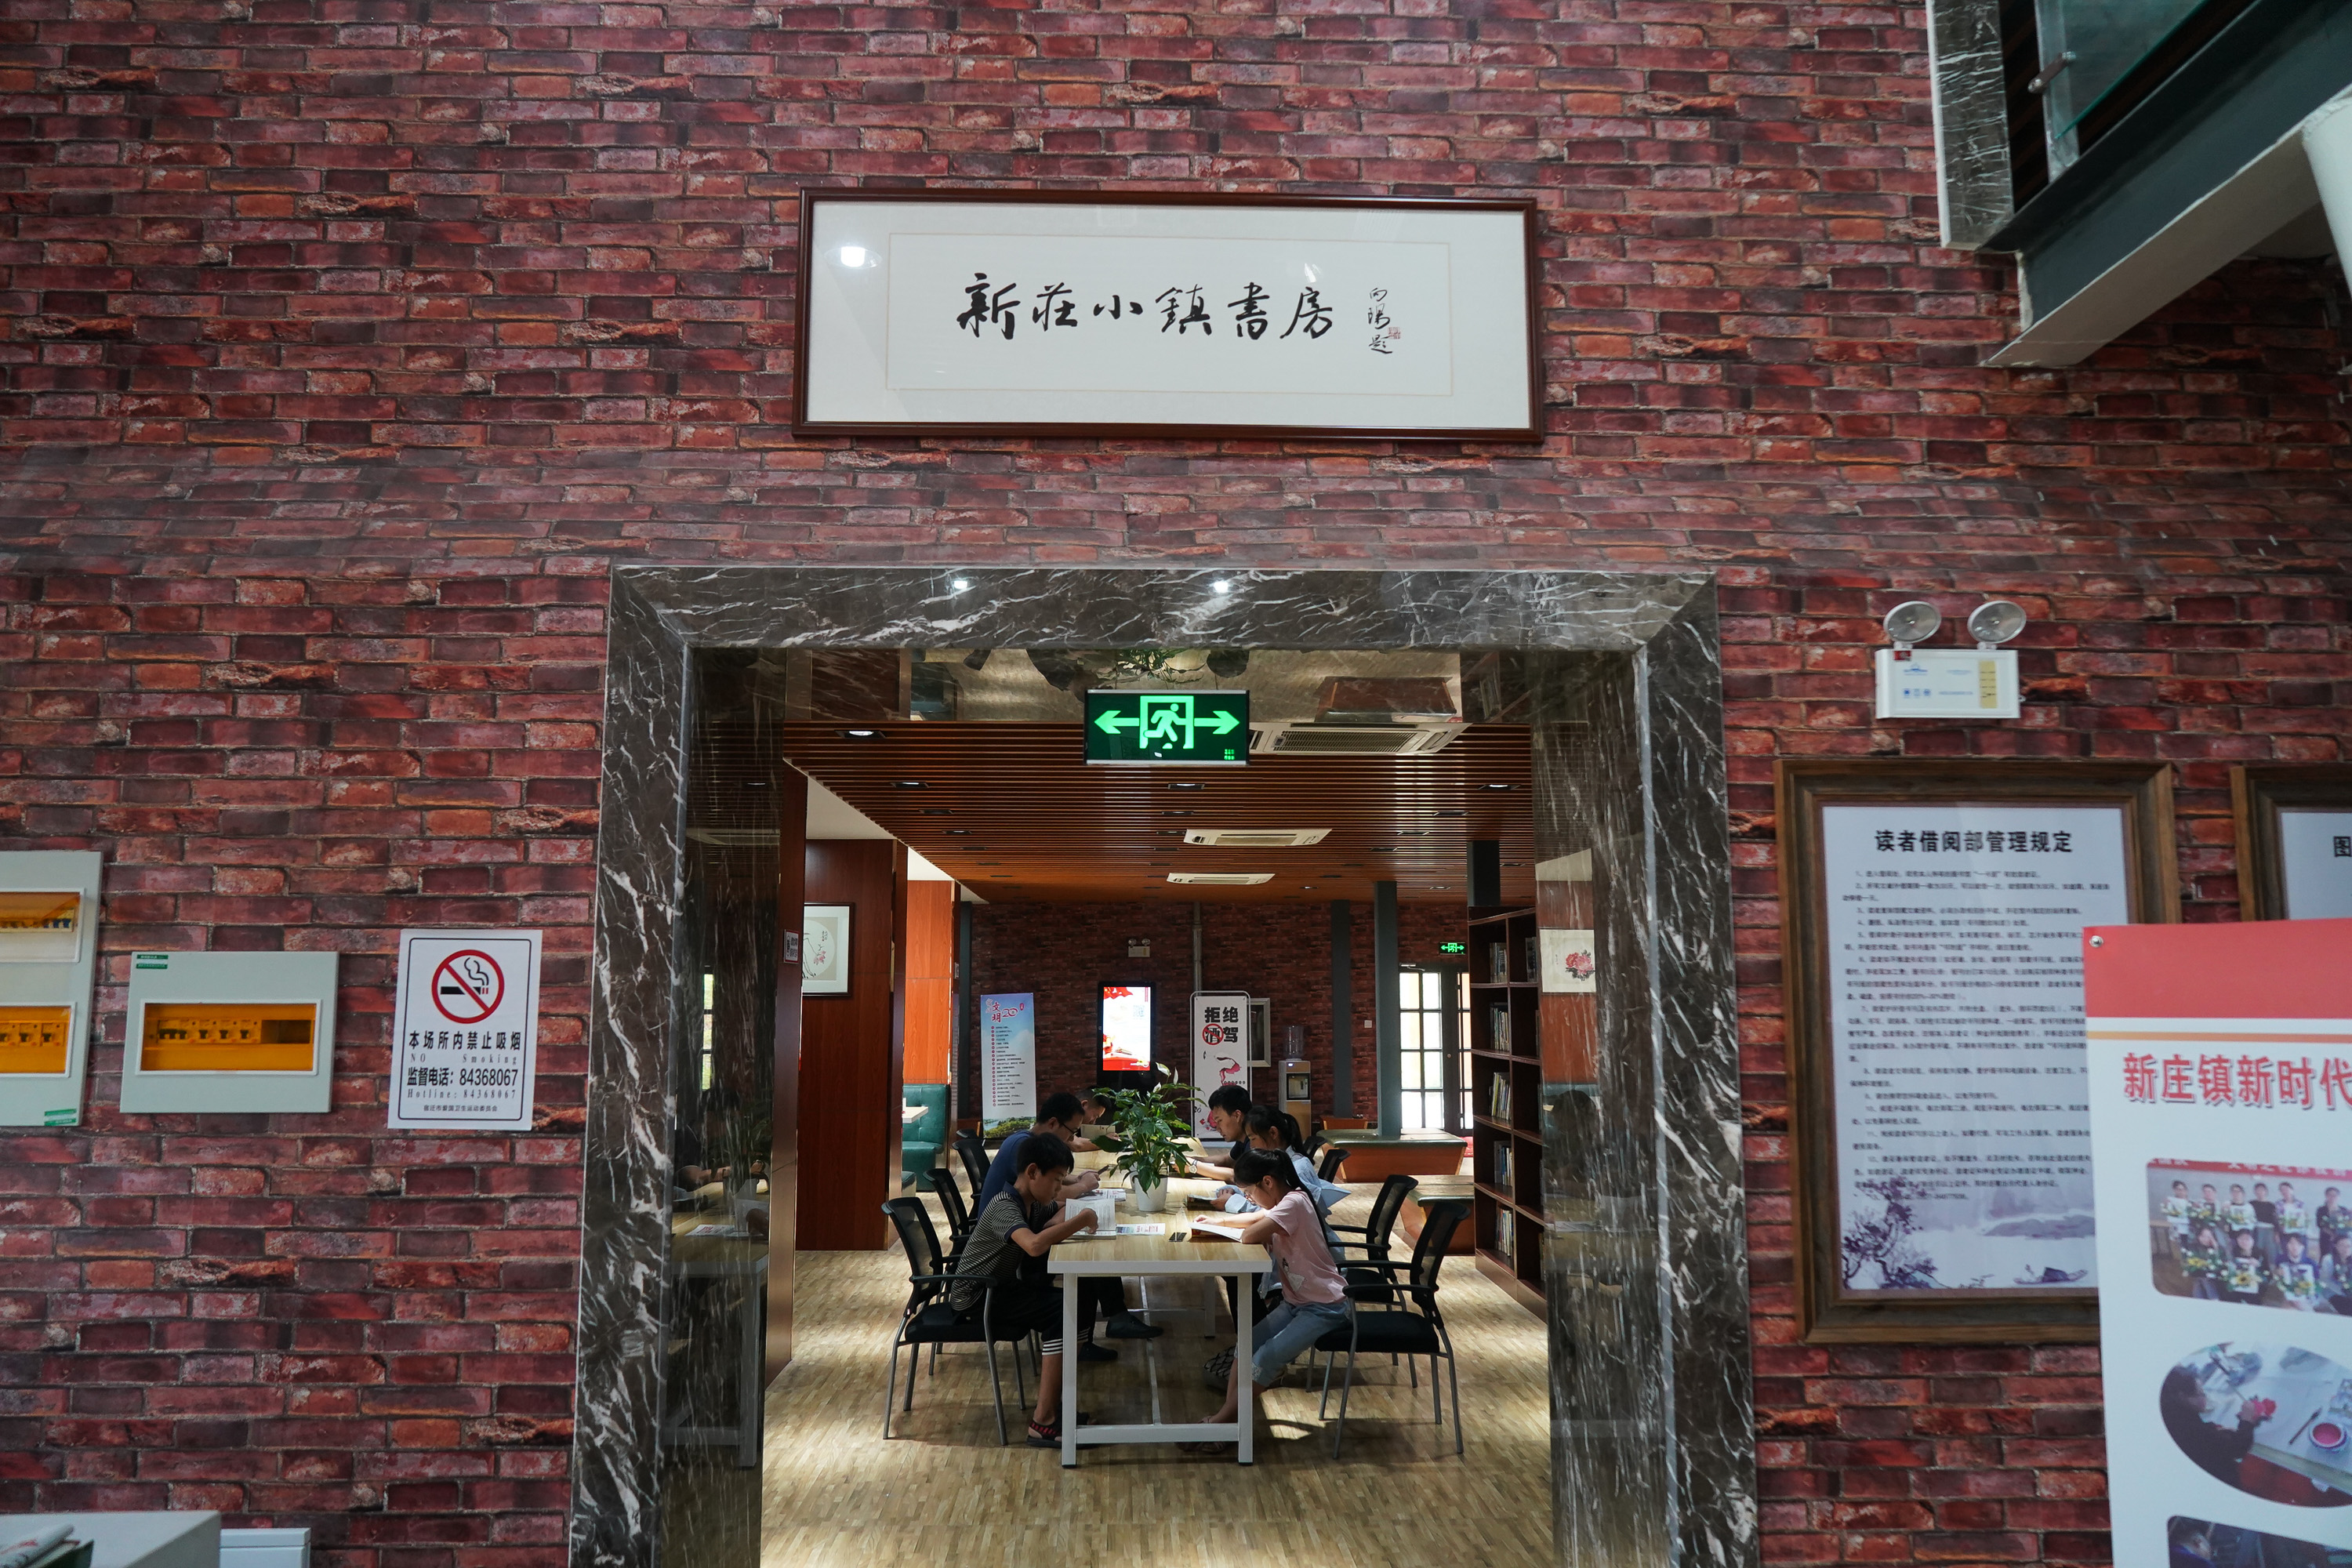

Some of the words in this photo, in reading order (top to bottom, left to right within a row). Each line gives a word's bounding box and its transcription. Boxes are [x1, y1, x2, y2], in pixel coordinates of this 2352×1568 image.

[1875, 829, 2073, 853] 读者借阅部管理规定
[1204, 1007, 1239, 1023] 拒绝
[408, 1030, 521, 1051] 本场所内禁止吸烟
[411, 1053, 426, 1062] NO
[463, 1054, 517, 1065] Smoking
[459, 1068, 518, 1087] 84368067
[2123, 1053, 2352, 1112] 新庄镇新时代
[408, 1088, 457, 1098] Hotline:
[463, 1089, 516, 1098] 84368067
